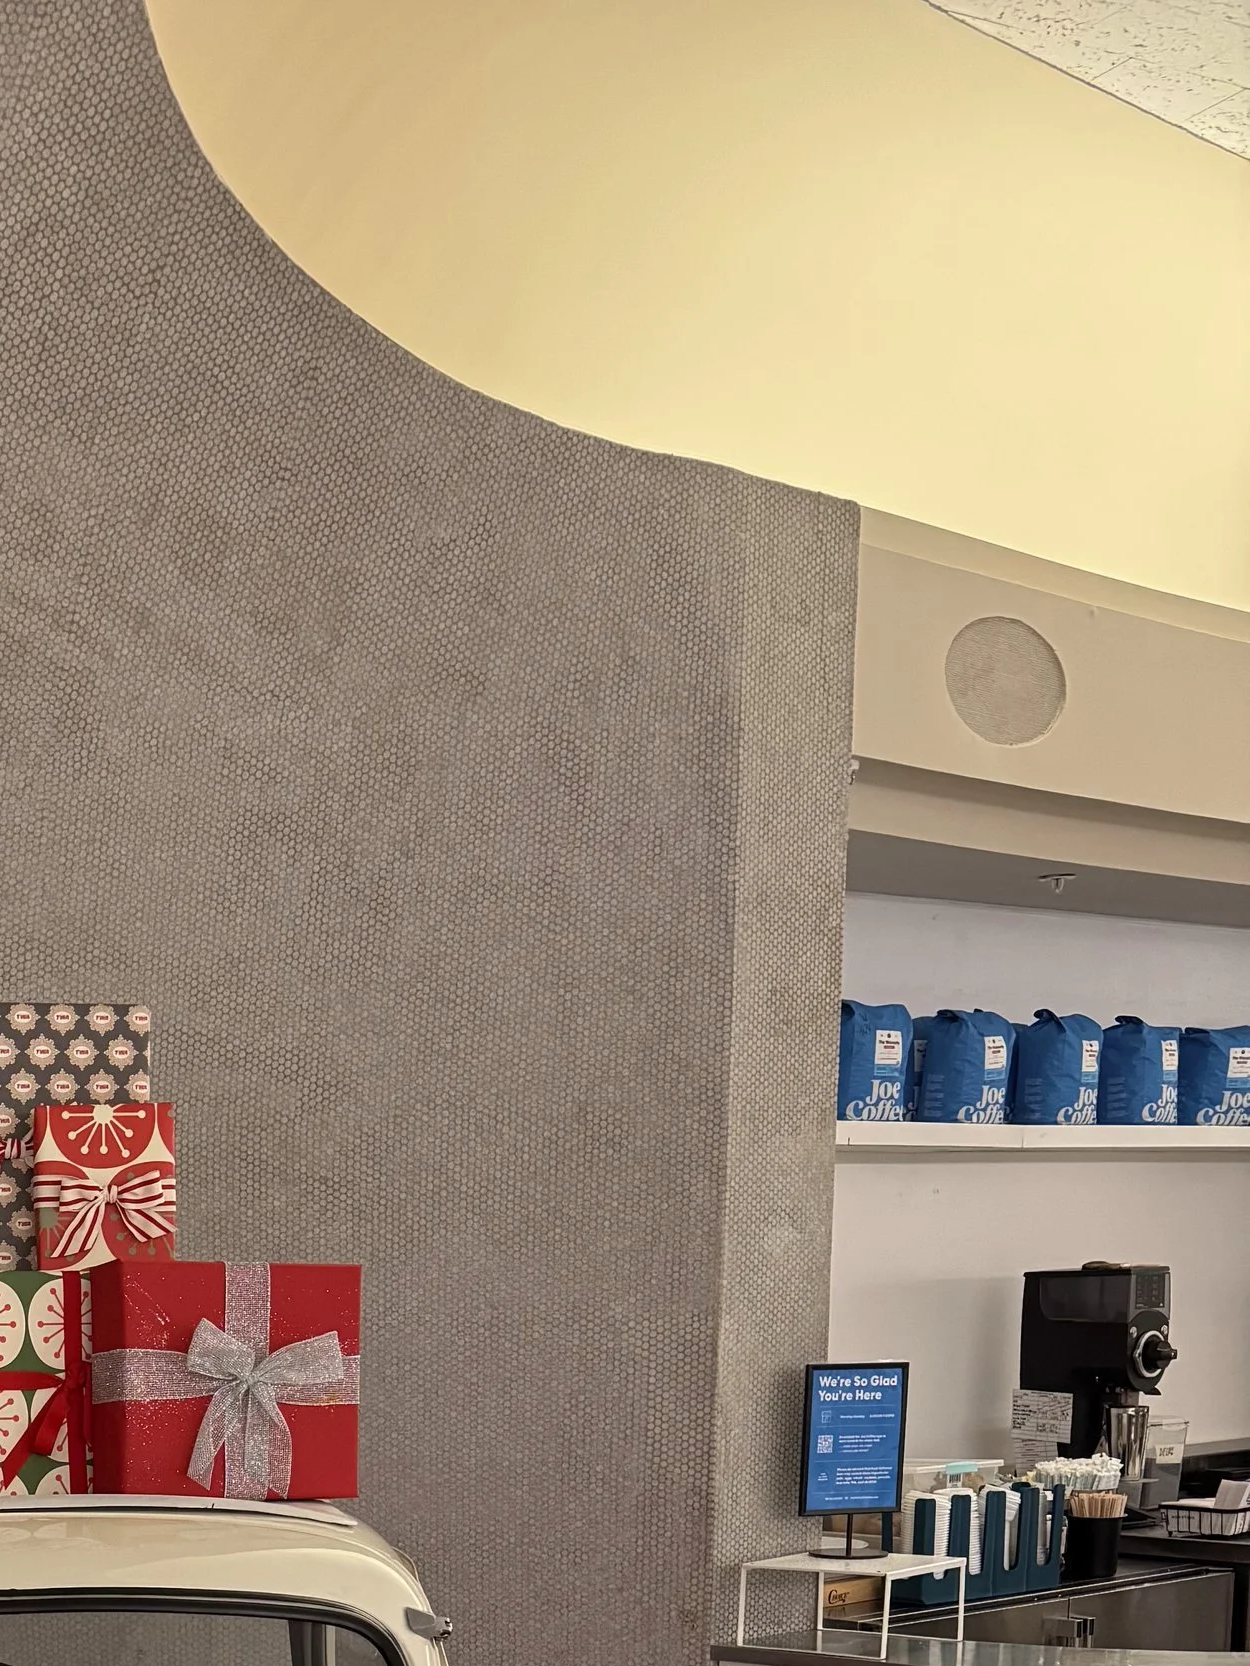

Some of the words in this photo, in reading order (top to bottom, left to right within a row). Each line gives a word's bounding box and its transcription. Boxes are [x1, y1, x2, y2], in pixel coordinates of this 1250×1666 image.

[866, 1080, 901, 1104] Joe
[846, 1100, 903, 1121] Coffe
[957, 1105, 1004, 1124] Coffe
[1196, 1108, 1250, 1126] Coffe
[819, 1376, 851, 1387] We're
[854, 1376, 867, 1387] So
[870, 1375, 897, 1386] Glad
[819, 1390, 853, 1401] You're
[856, 1390, 882, 1400] Here
